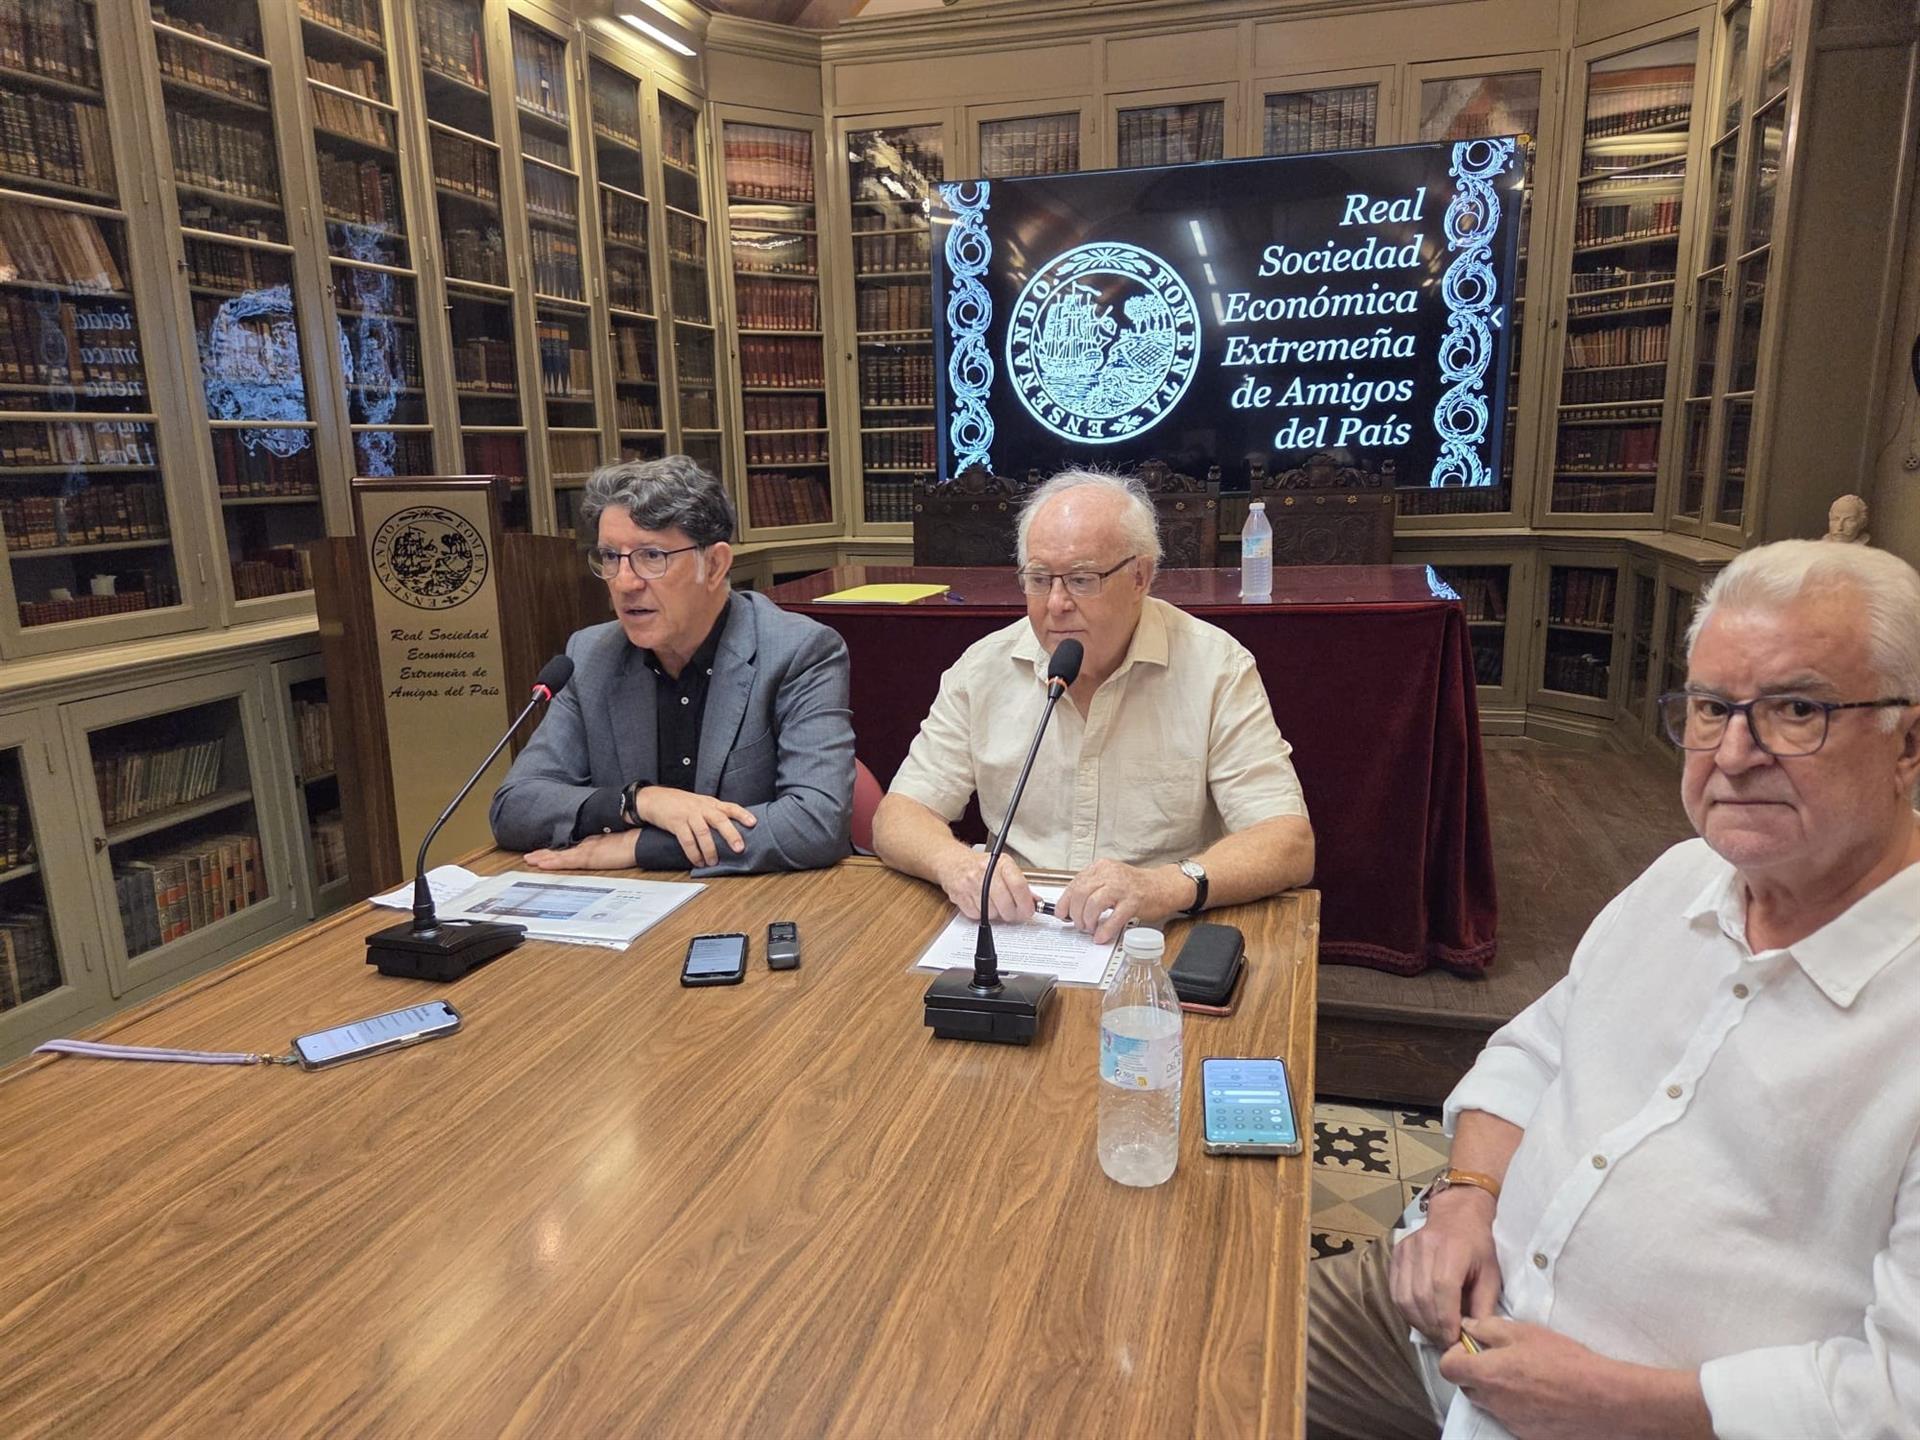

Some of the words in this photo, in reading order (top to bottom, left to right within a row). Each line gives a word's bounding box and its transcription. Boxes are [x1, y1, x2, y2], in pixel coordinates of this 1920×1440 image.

[1339, 187, 1427, 226] Real
[1259, 234, 1423, 277] Sociedad
[1221, 282, 1419, 325] Económica
[1142, 266, 1195, 415] FOMENTA
[1221, 328, 1417, 367] Extremeña
[1231, 374, 1272, 410] de
[1275, 373, 1414, 412] Amigos
[1275, 417, 1328, 450] del
[1331, 415, 1413, 448] País
[390, 629, 423, 641] Real
[428, 628, 489, 641] Sociedad
[407, 647, 476, 661] Económica
[388, 686, 439, 701] Amigos
[444, 686, 465, 697] del
[469, 683, 499, 697] País
[400, 666, 467, 680] Extremeña
[471, 667, 488, 677] de
